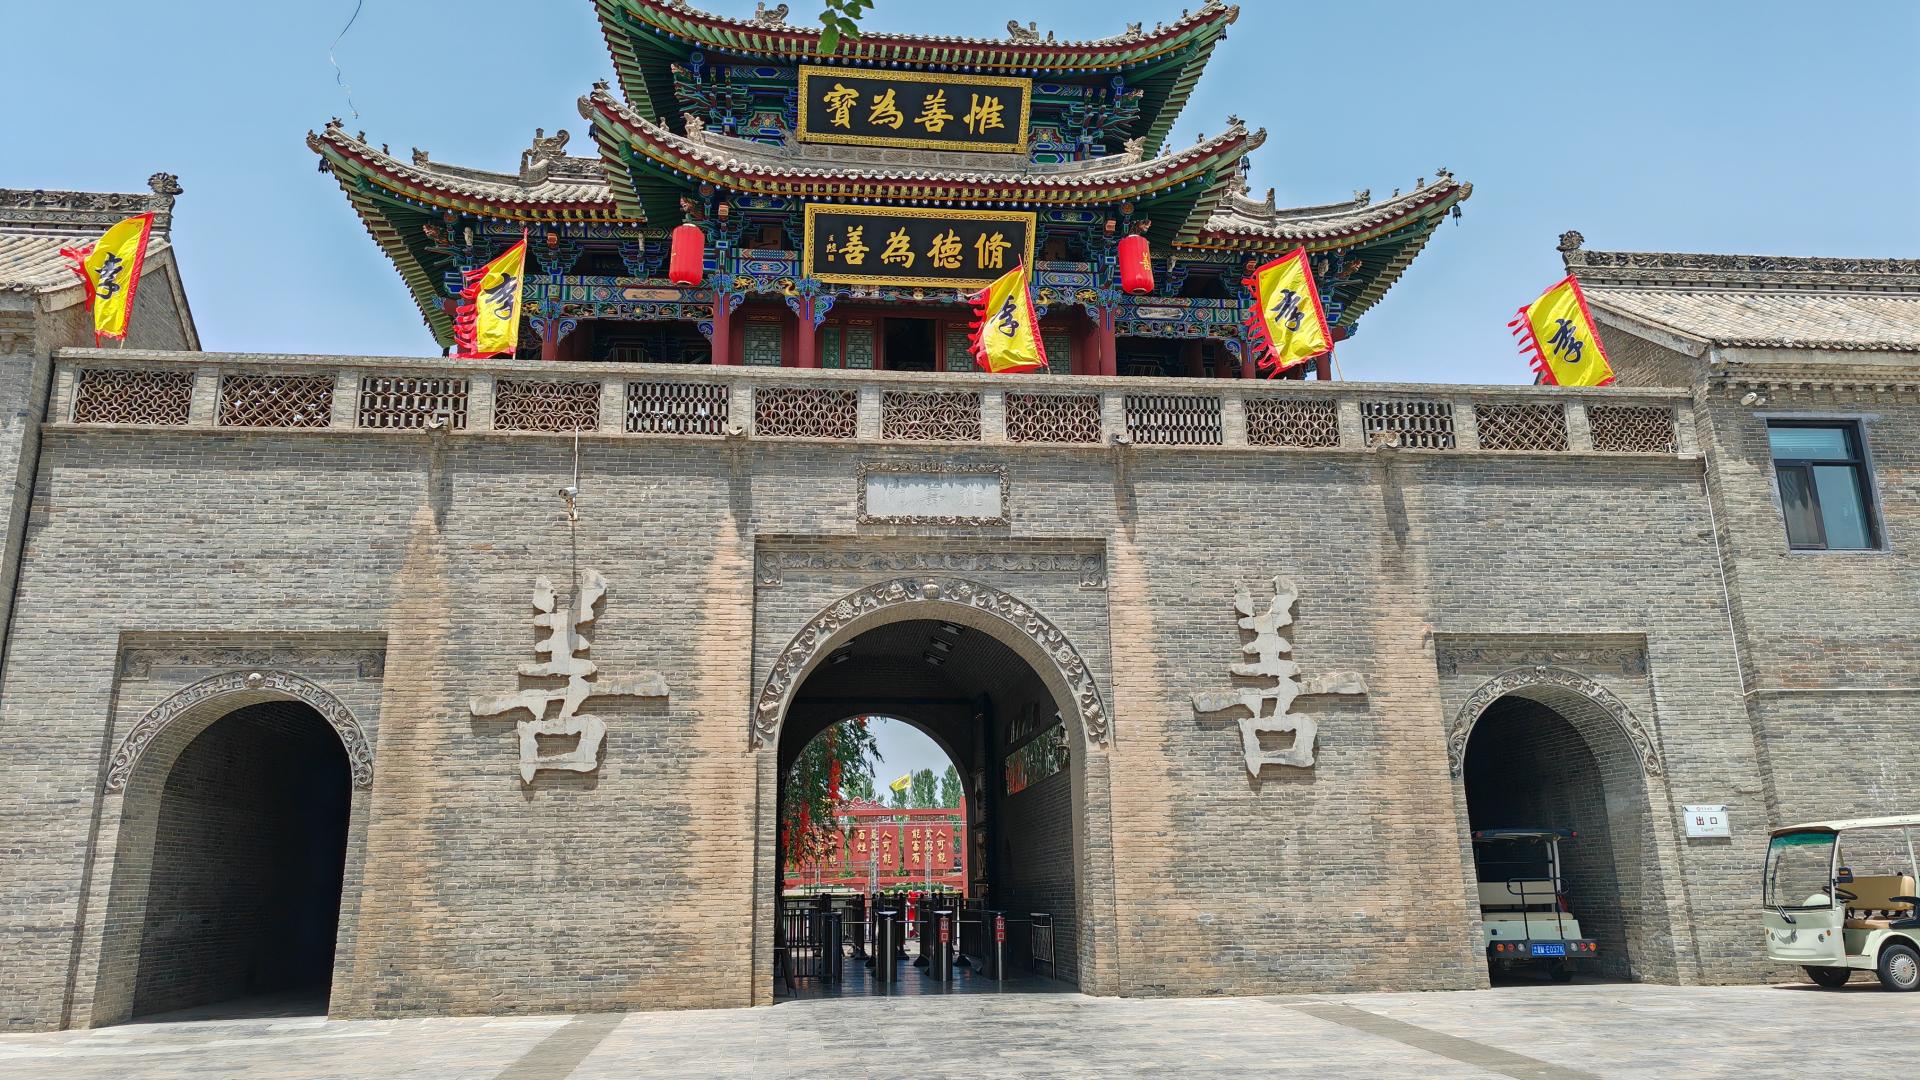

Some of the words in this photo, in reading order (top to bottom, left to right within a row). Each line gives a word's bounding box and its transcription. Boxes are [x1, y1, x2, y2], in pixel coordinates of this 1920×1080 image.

[469, 568, 670, 784] 善
[1191, 575, 1368, 778] 善
[1696, 816, 1718, 825] 出口
[941, 920, 949, 940] 出口
[997, 920, 1005, 940] 出口
